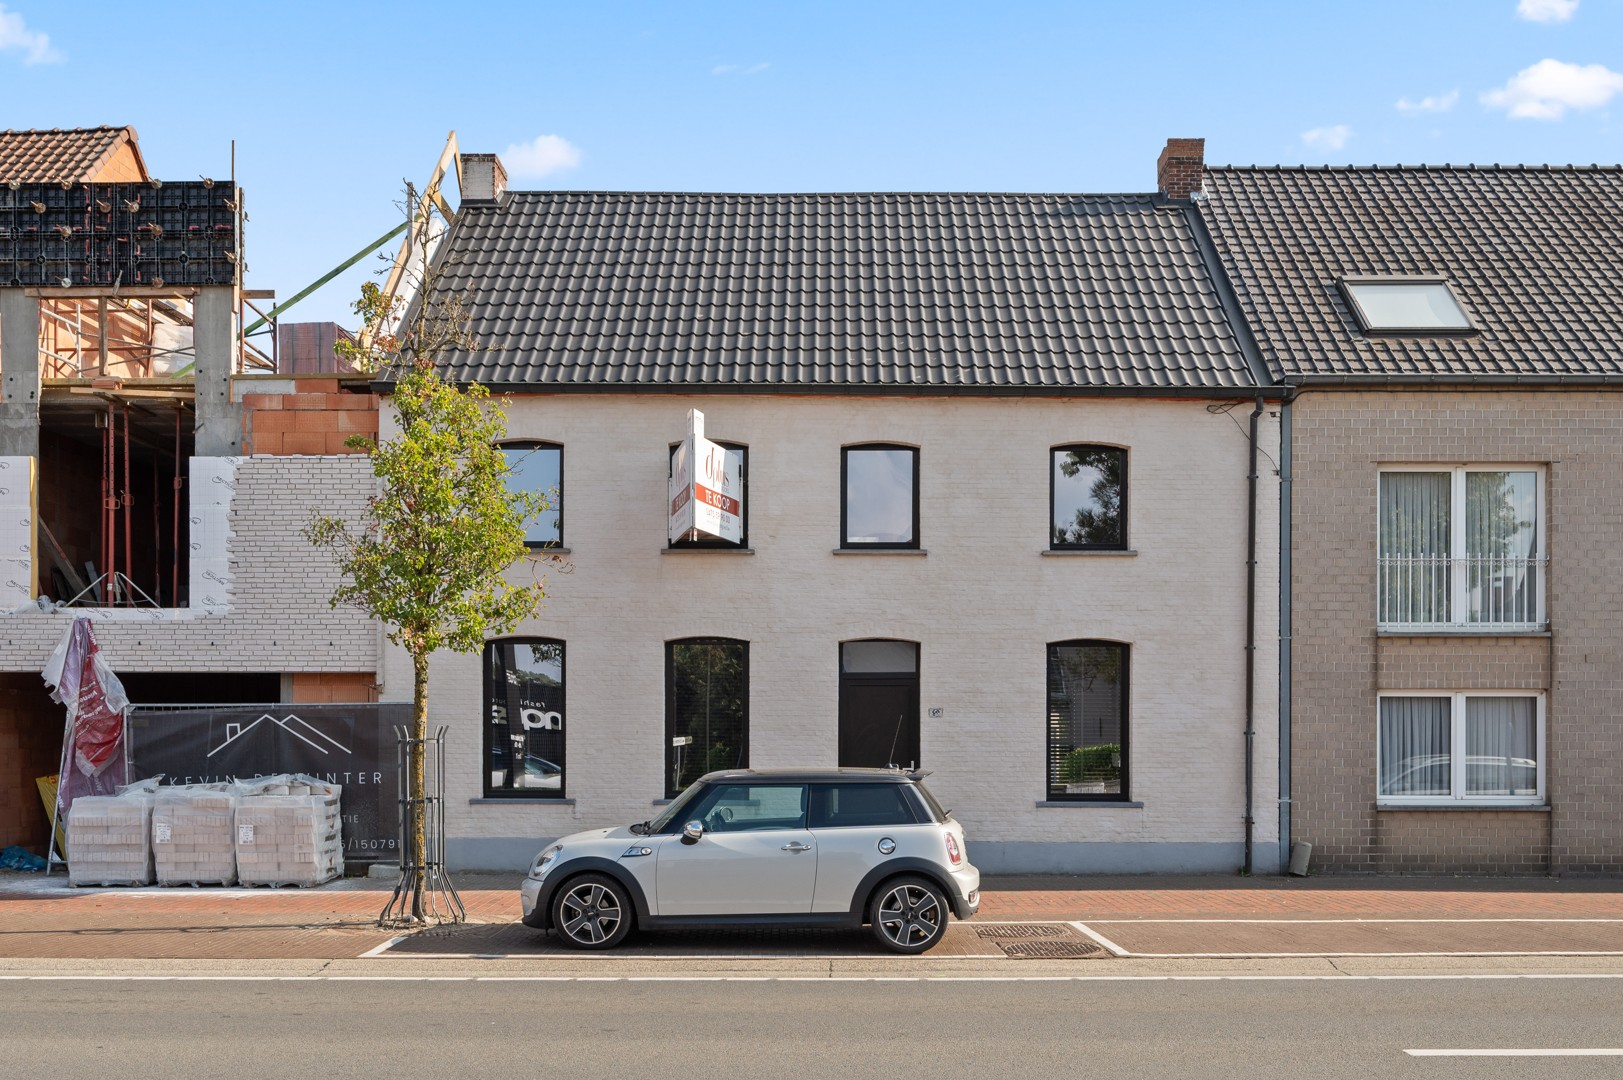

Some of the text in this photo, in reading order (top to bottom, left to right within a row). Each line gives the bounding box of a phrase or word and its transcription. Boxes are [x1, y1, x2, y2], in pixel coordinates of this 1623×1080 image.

[705, 489, 712, 504] TE
[713, 492, 731, 510] KOOP
[311, 772, 382, 785] INTER
[341, 814, 359, 823] TIE
